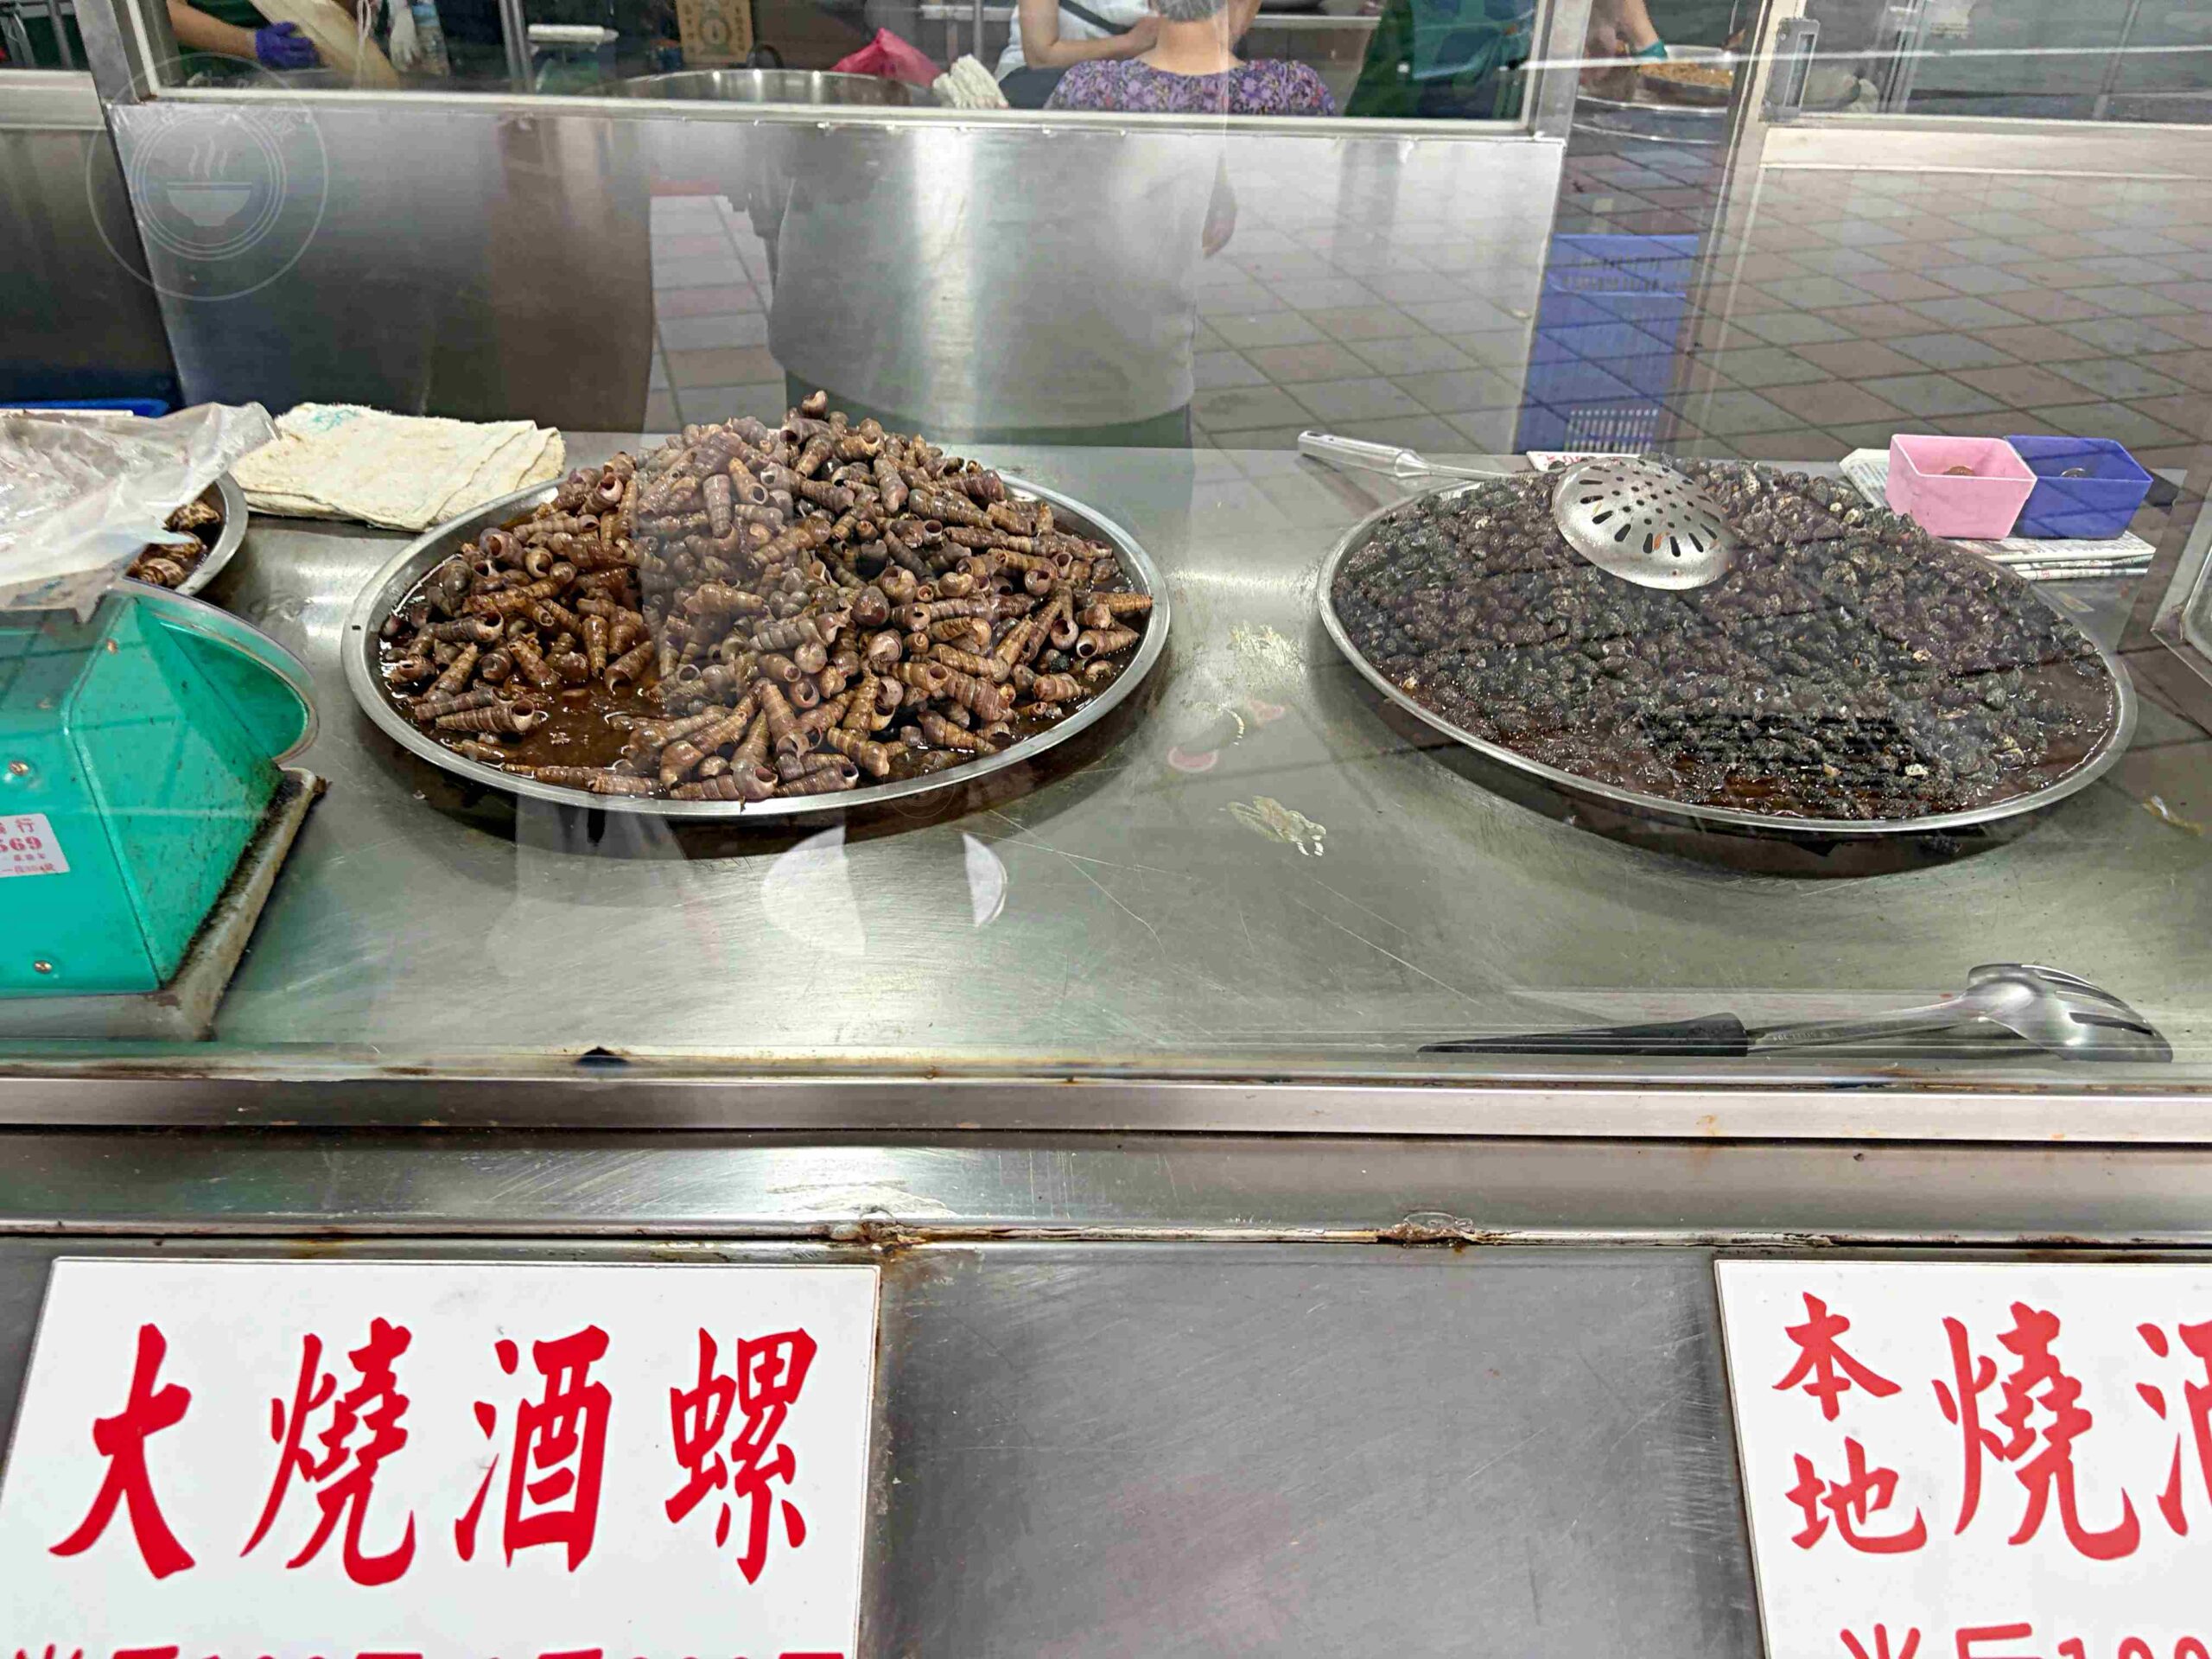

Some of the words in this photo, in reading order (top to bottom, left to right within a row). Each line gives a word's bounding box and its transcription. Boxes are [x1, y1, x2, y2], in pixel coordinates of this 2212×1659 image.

[48, 1317, 817, 1586] 大燒酒螺
[1772, 1292, 1928, 1554] 本地
